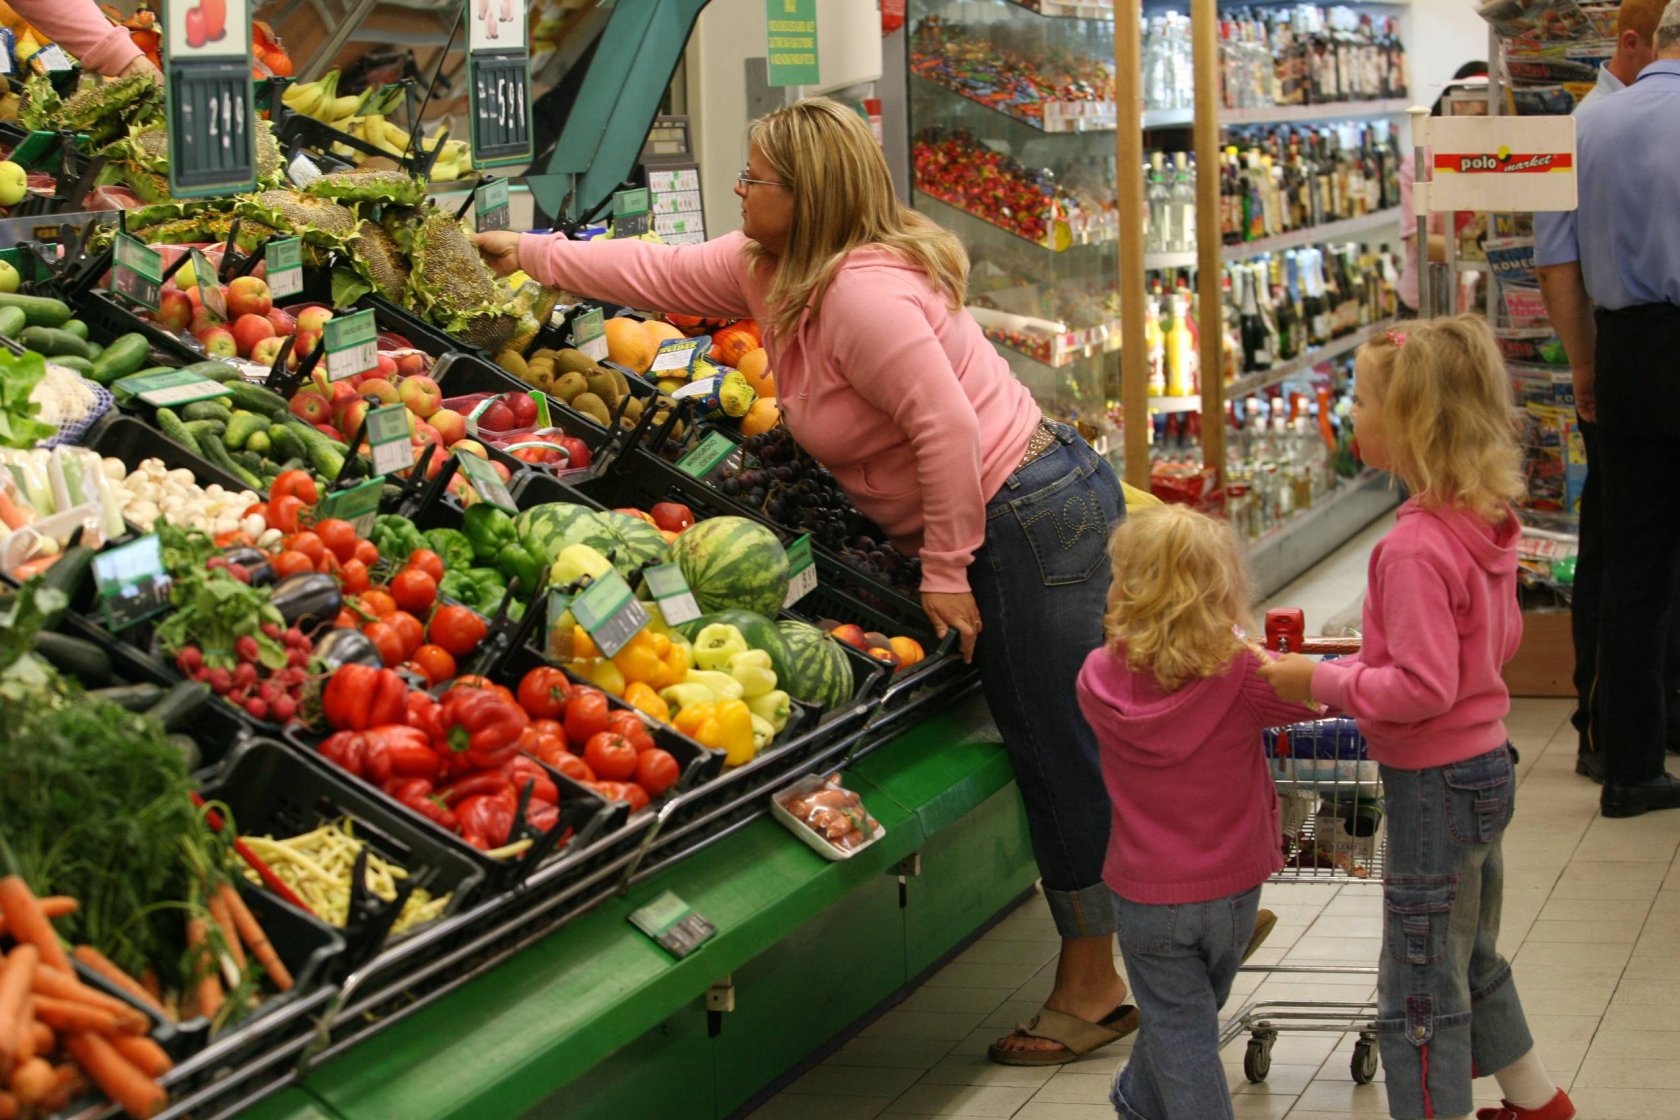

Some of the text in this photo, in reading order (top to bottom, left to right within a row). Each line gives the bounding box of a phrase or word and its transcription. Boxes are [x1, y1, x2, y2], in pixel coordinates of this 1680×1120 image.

[1461, 154, 1552, 172] polo market
[686, 439, 717, 467] WINOGRONO
[699, 449, 720, 467] CIEMNE
